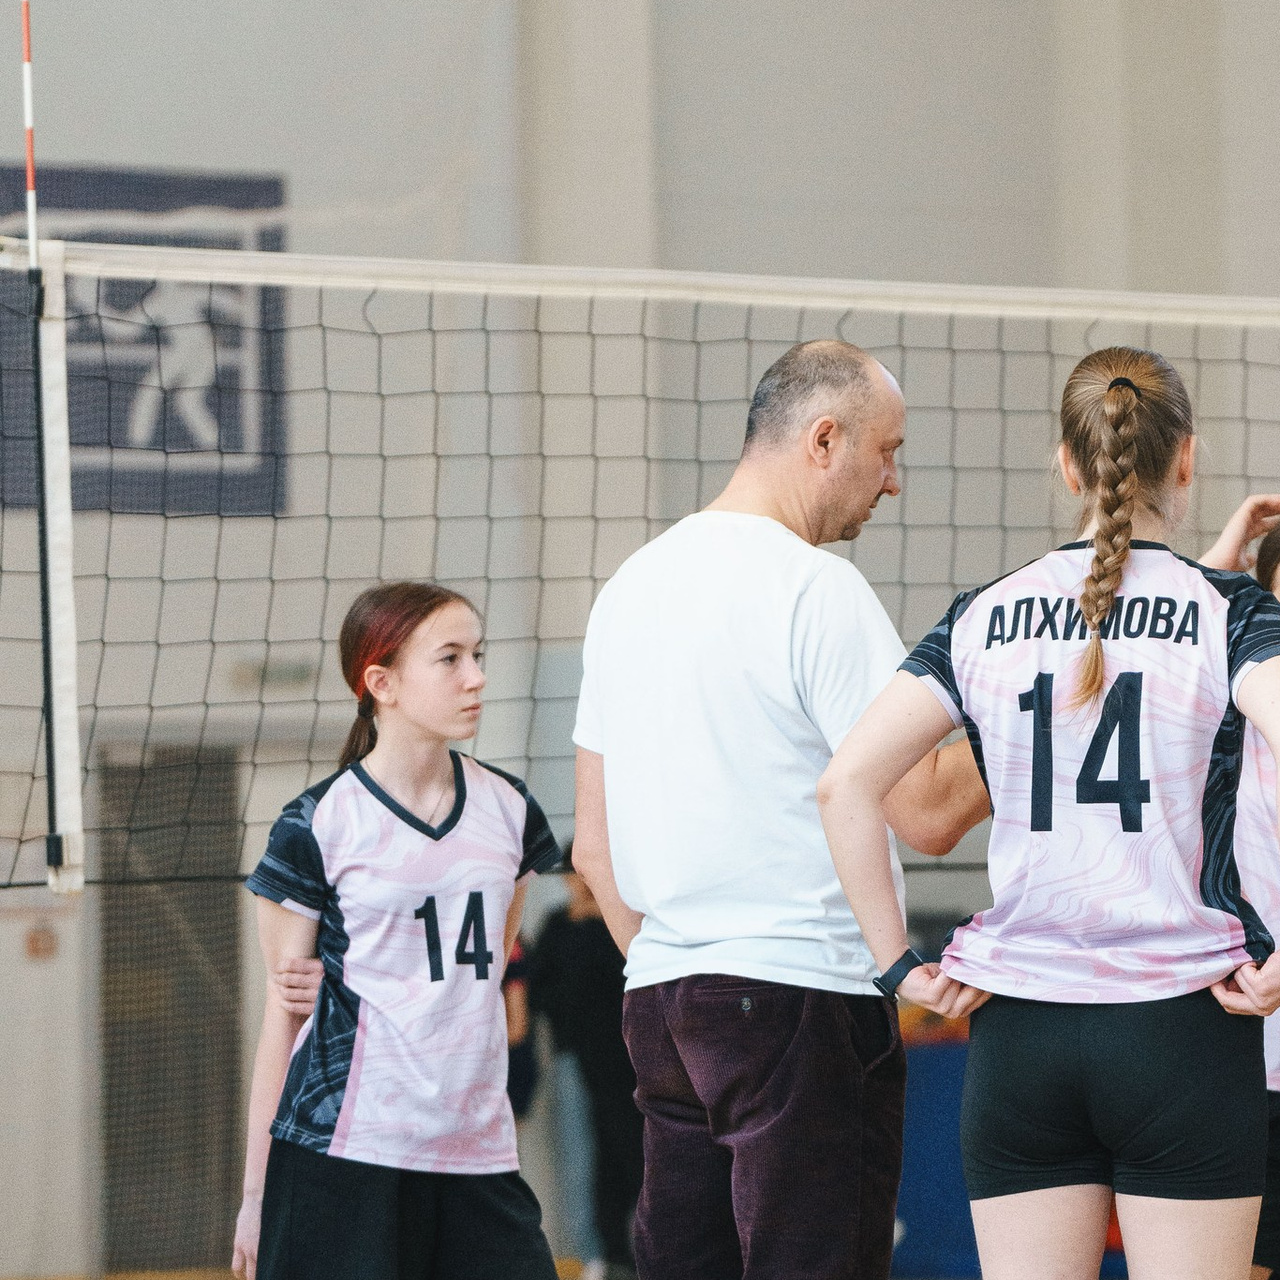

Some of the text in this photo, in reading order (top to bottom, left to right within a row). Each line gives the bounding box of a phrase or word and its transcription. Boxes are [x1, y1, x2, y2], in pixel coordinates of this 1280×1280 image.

[985, 596, 1199, 650] АЛХИМОВА
[1018, 671, 1150, 833] 14
[413, 890, 494, 983] 14
